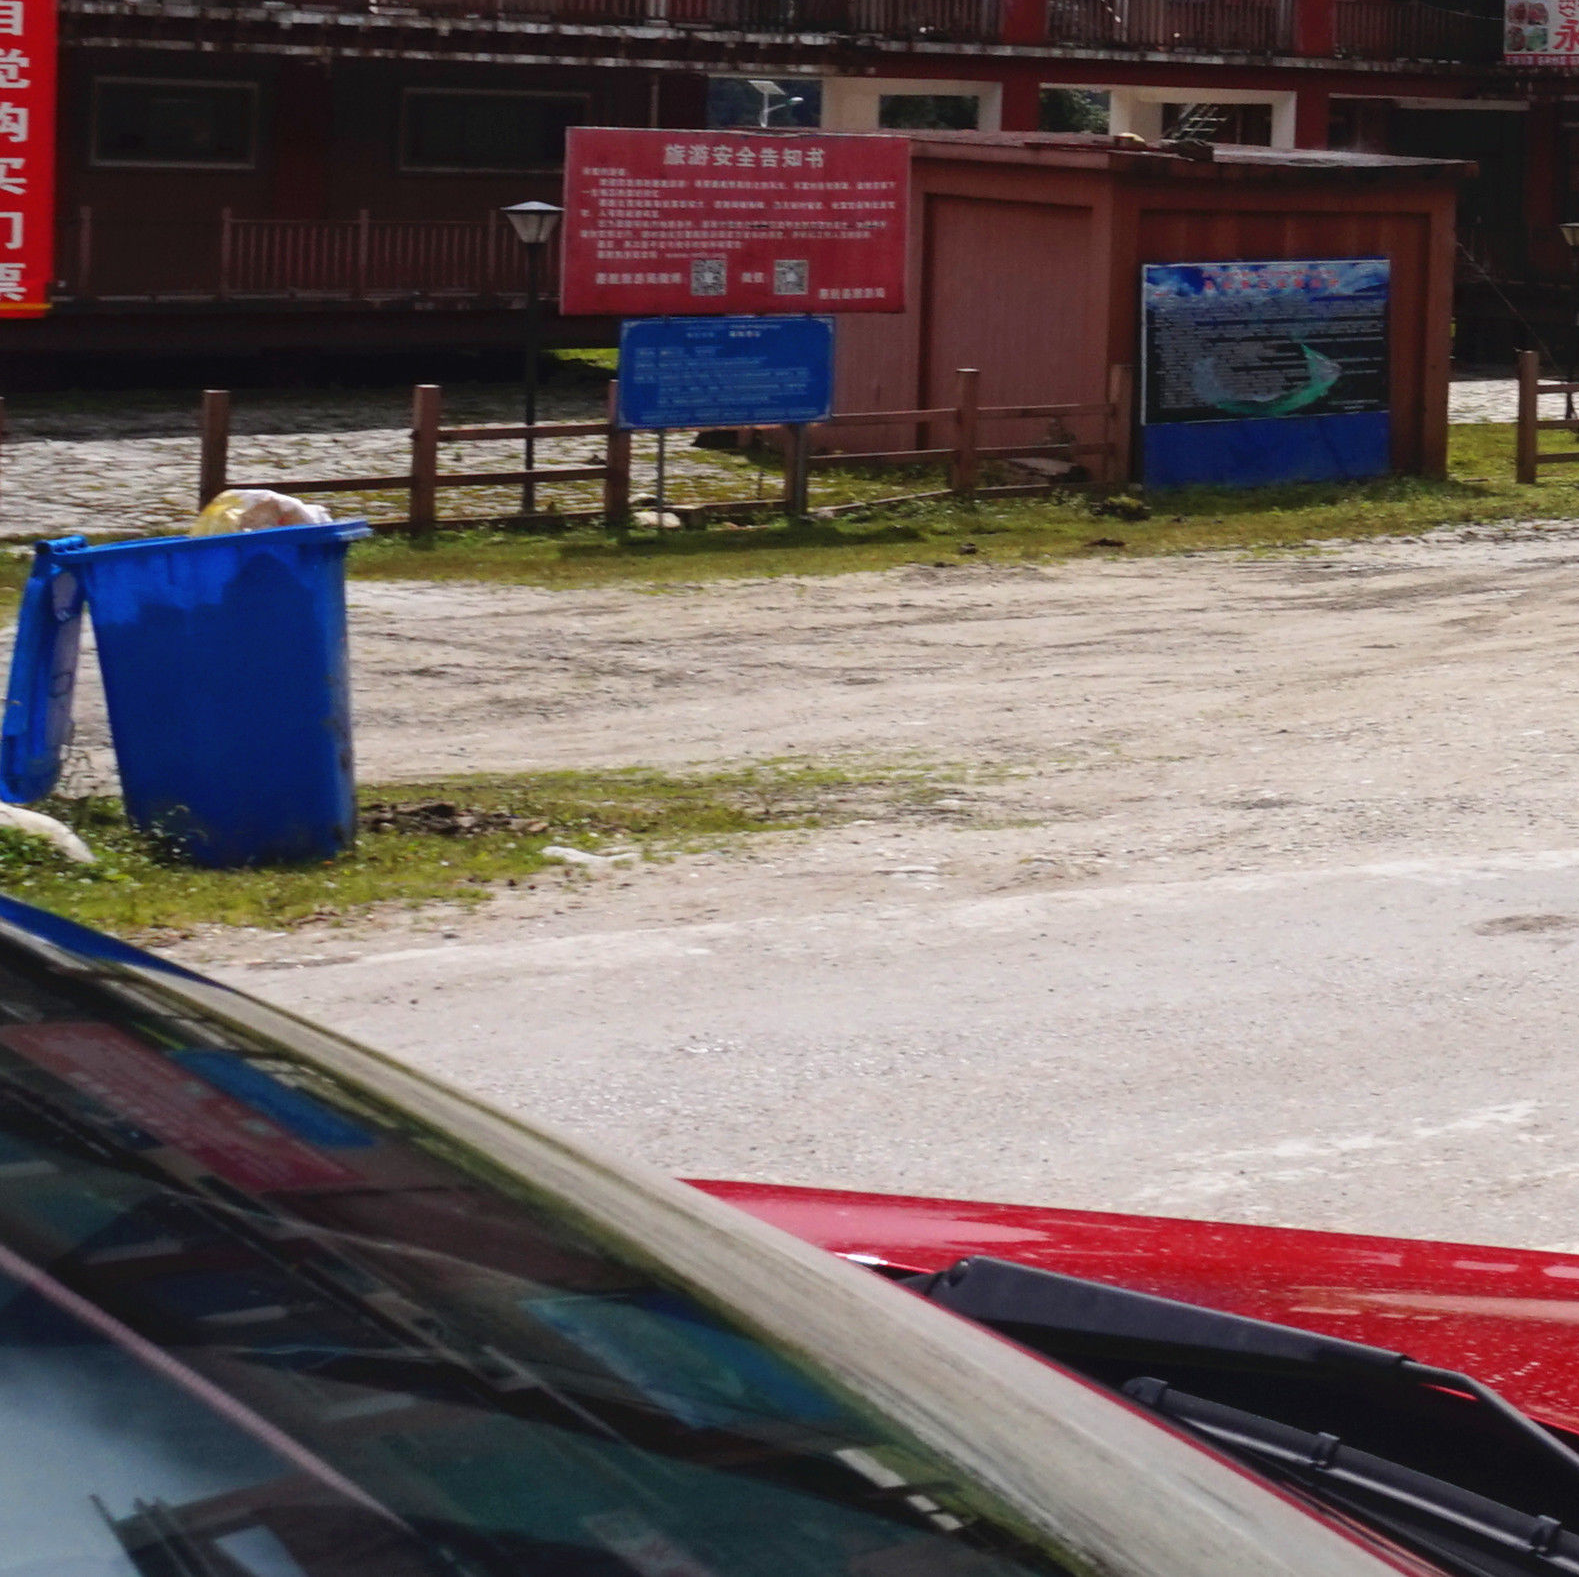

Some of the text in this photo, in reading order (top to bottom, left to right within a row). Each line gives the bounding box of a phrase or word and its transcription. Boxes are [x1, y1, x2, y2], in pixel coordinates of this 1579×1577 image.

[663, 143, 826, 169] 旅游安全告知书
